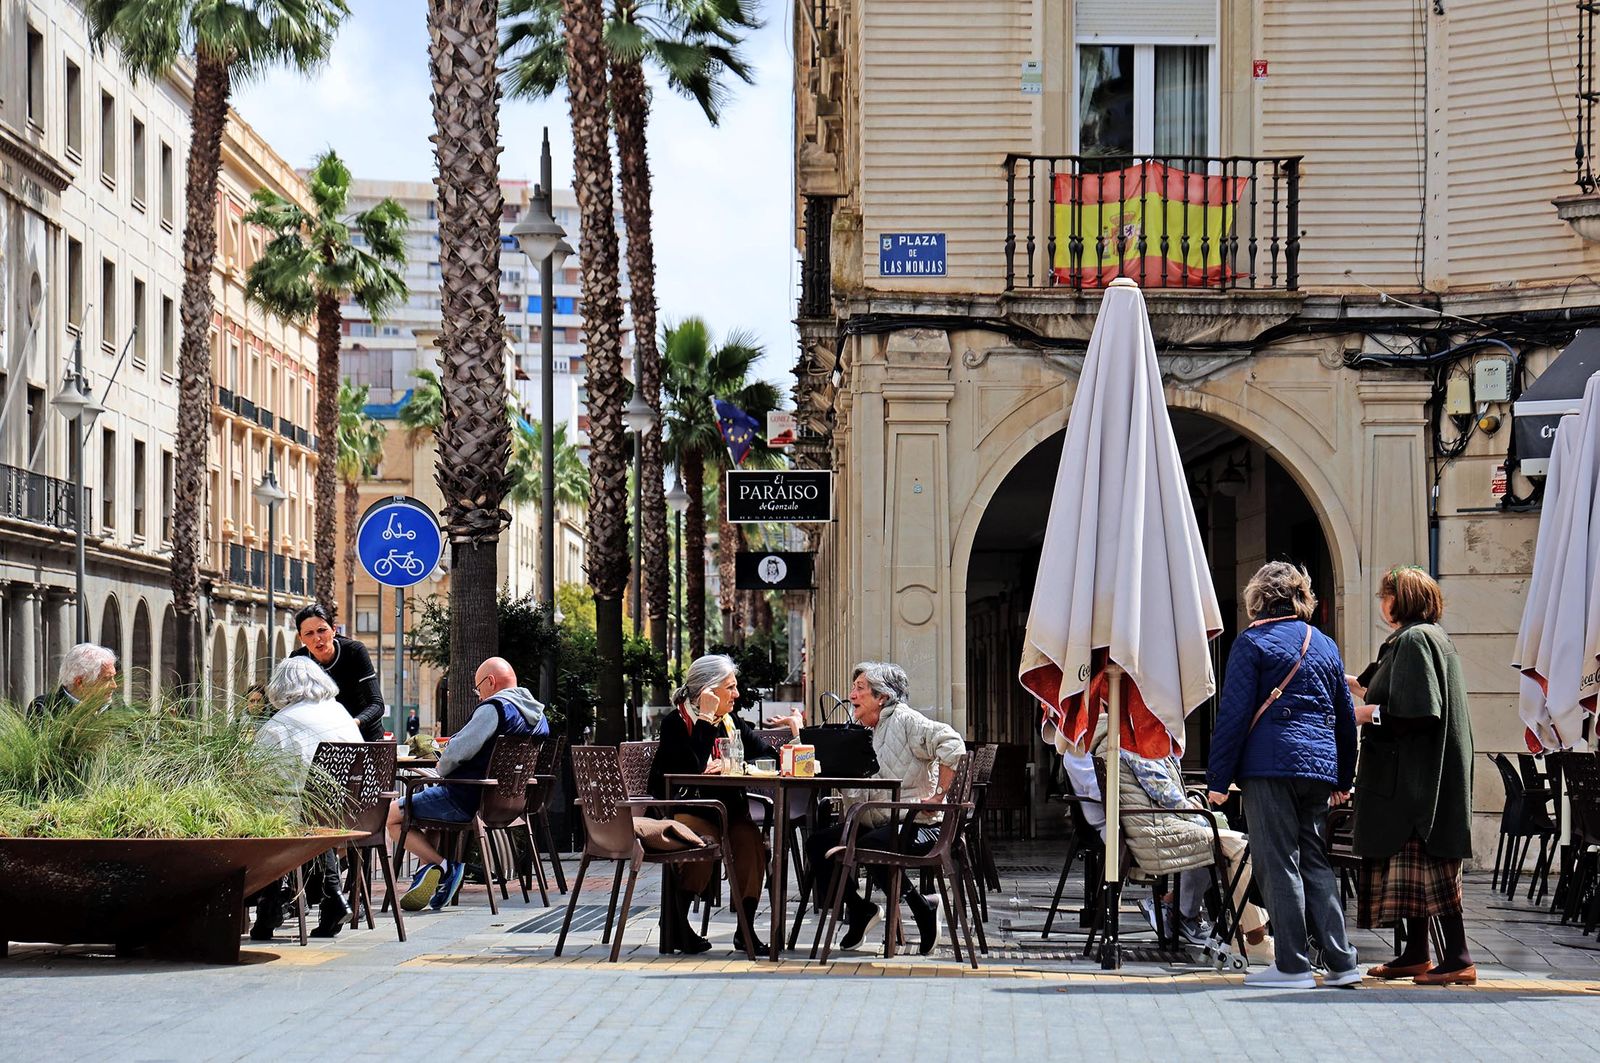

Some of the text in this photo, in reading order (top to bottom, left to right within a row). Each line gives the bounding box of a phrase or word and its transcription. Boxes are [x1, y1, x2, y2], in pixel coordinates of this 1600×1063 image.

[899, 235, 937, 246] PLAZA
[908, 248, 918, 257] DE
[884, 260, 943, 273] LAS MONJAS
[1540, 424, 1557, 439] Cr
[773, 474, 784, 485] El
